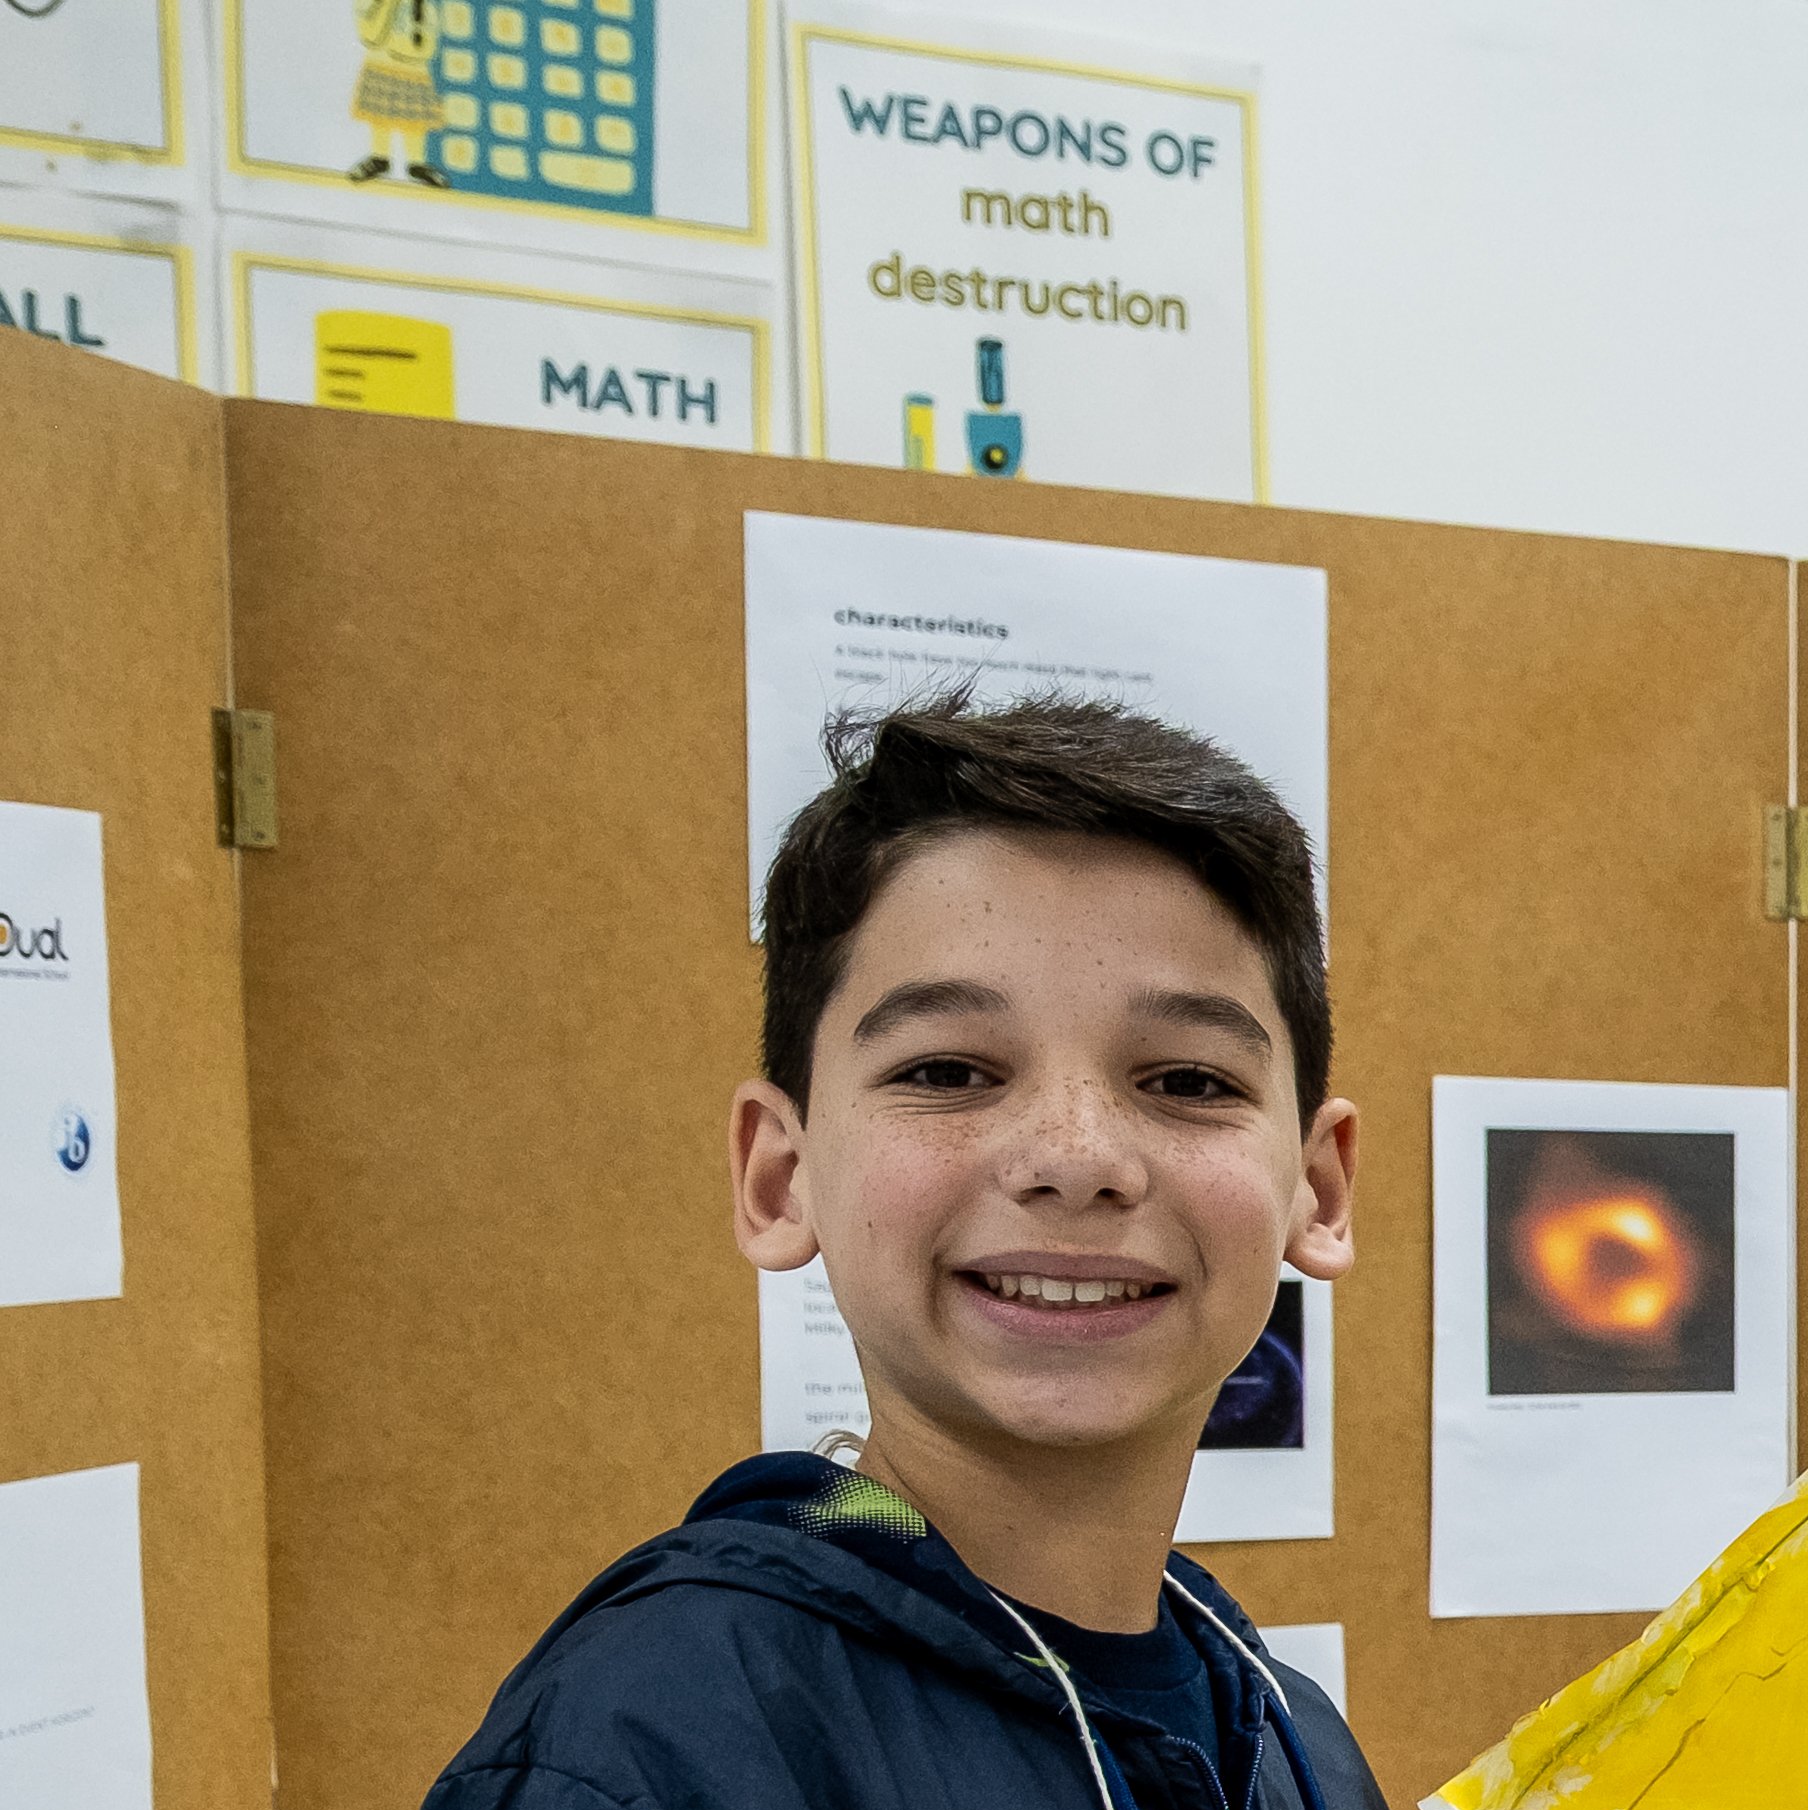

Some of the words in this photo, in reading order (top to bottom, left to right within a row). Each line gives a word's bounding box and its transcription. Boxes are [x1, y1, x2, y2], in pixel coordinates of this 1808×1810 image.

[838, 84, 1129, 168] WEAPONS
[1146, 130, 1218, 178] OF
[961, 186, 1111, 238] math
[868, 250, 1188, 331] destruction
[541, 357, 718, 424] MATH
[833, 606, 1009, 640] characteristics
